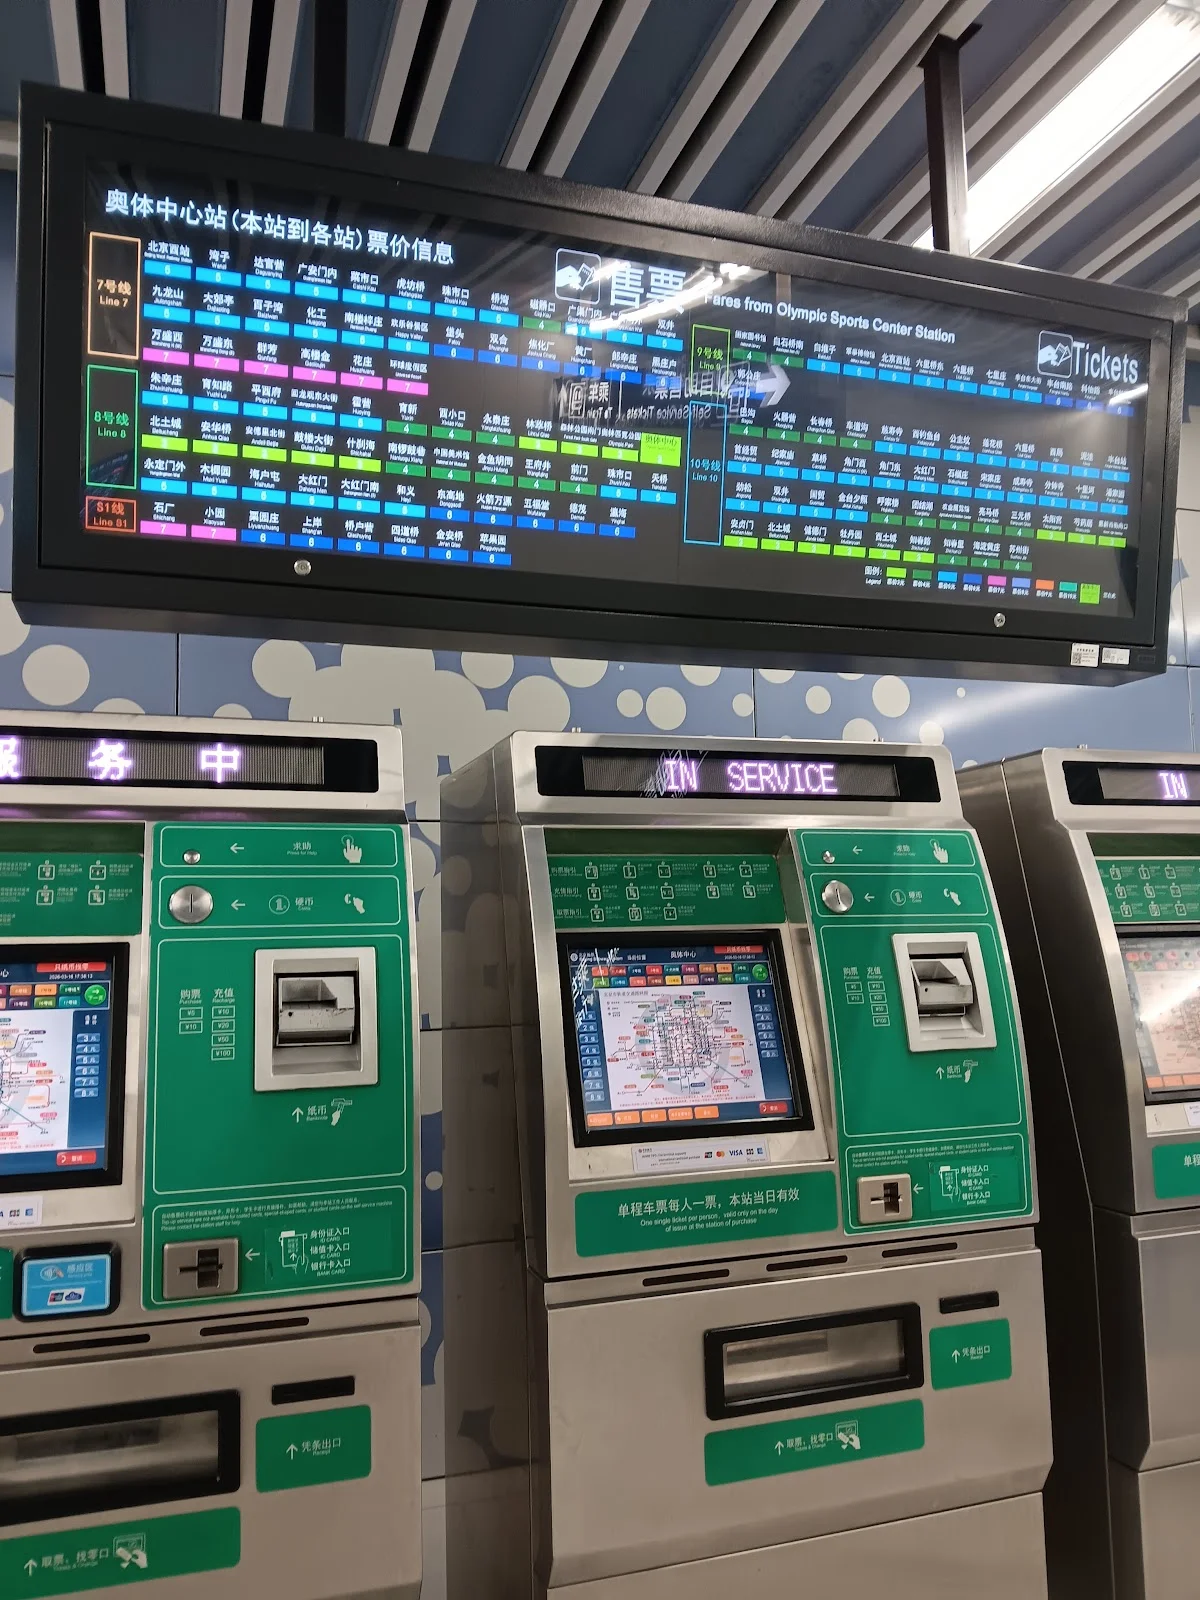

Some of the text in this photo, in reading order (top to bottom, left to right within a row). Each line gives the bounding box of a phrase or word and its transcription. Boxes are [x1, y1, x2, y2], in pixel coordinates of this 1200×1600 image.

[105, 188, 454, 265] 奥体中心站(本站到各站)票价信息
[297, 263, 337, 280] 广安门内
[96, 279, 132, 295] 7号线
[151, 285, 184, 300] 九龙山
[99, 295, 129, 308] Line 7
[306, 307, 327, 320] 化工
[744, 296, 772, 314] from
[777, 302, 827, 326] Olympic
[831, 312, 869, 330] Sports
[873, 318, 912, 337] Center
[916, 325, 955, 344] Station
[163, 352, 169, 361] 7
[697, 346, 724, 361] 9号线
[214, 359, 219, 368] 7
[700, 361, 713, 369] Line
[1073, 341, 1139, 384] Tickets
[94, 411, 130, 426] 8号线
[98, 426, 126, 439] Line 8
[403, 424, 409, 434] 4
[448, 429, 454, 439] 4
[571, 463, 588, 476] 前门
[690, 459, 721, 472] 10号线
[692, 474, 707, 482] Line
[96, 502, 125, 515] S1线
[93, 517, 127, 527] Line S1
[665, 760, 838, 793] IN SERVICE
[1160, 772, 1188, 799] IN
[292, 841, 312, 851] 求助
[295, 897, 314, 907] 硬币
[180, 989, 201, 1000] 购票
[214, 988, 234, 998] 充值
[307, 1105, 327, 1116] 纸币
[654, 1217, 671, 1226] single
[672, 1216, 687, 1224] ticket
[688, 1215, 697, 1223] per
[737, 1210, 749, 1218] only
[706, 1220, 724, 1228] station
[732, 1217, 757, 1226] purchase
[310, 1227, 350, 1239] 身份证入口
[310, 1243, 350, 1255] 储值卡入口
[311, 1259, 351, 1271] 银行卡入口
[962, 1345, 990, 1357] 凭条出口
[301, 1438, 342, 1453] 凭条出口
